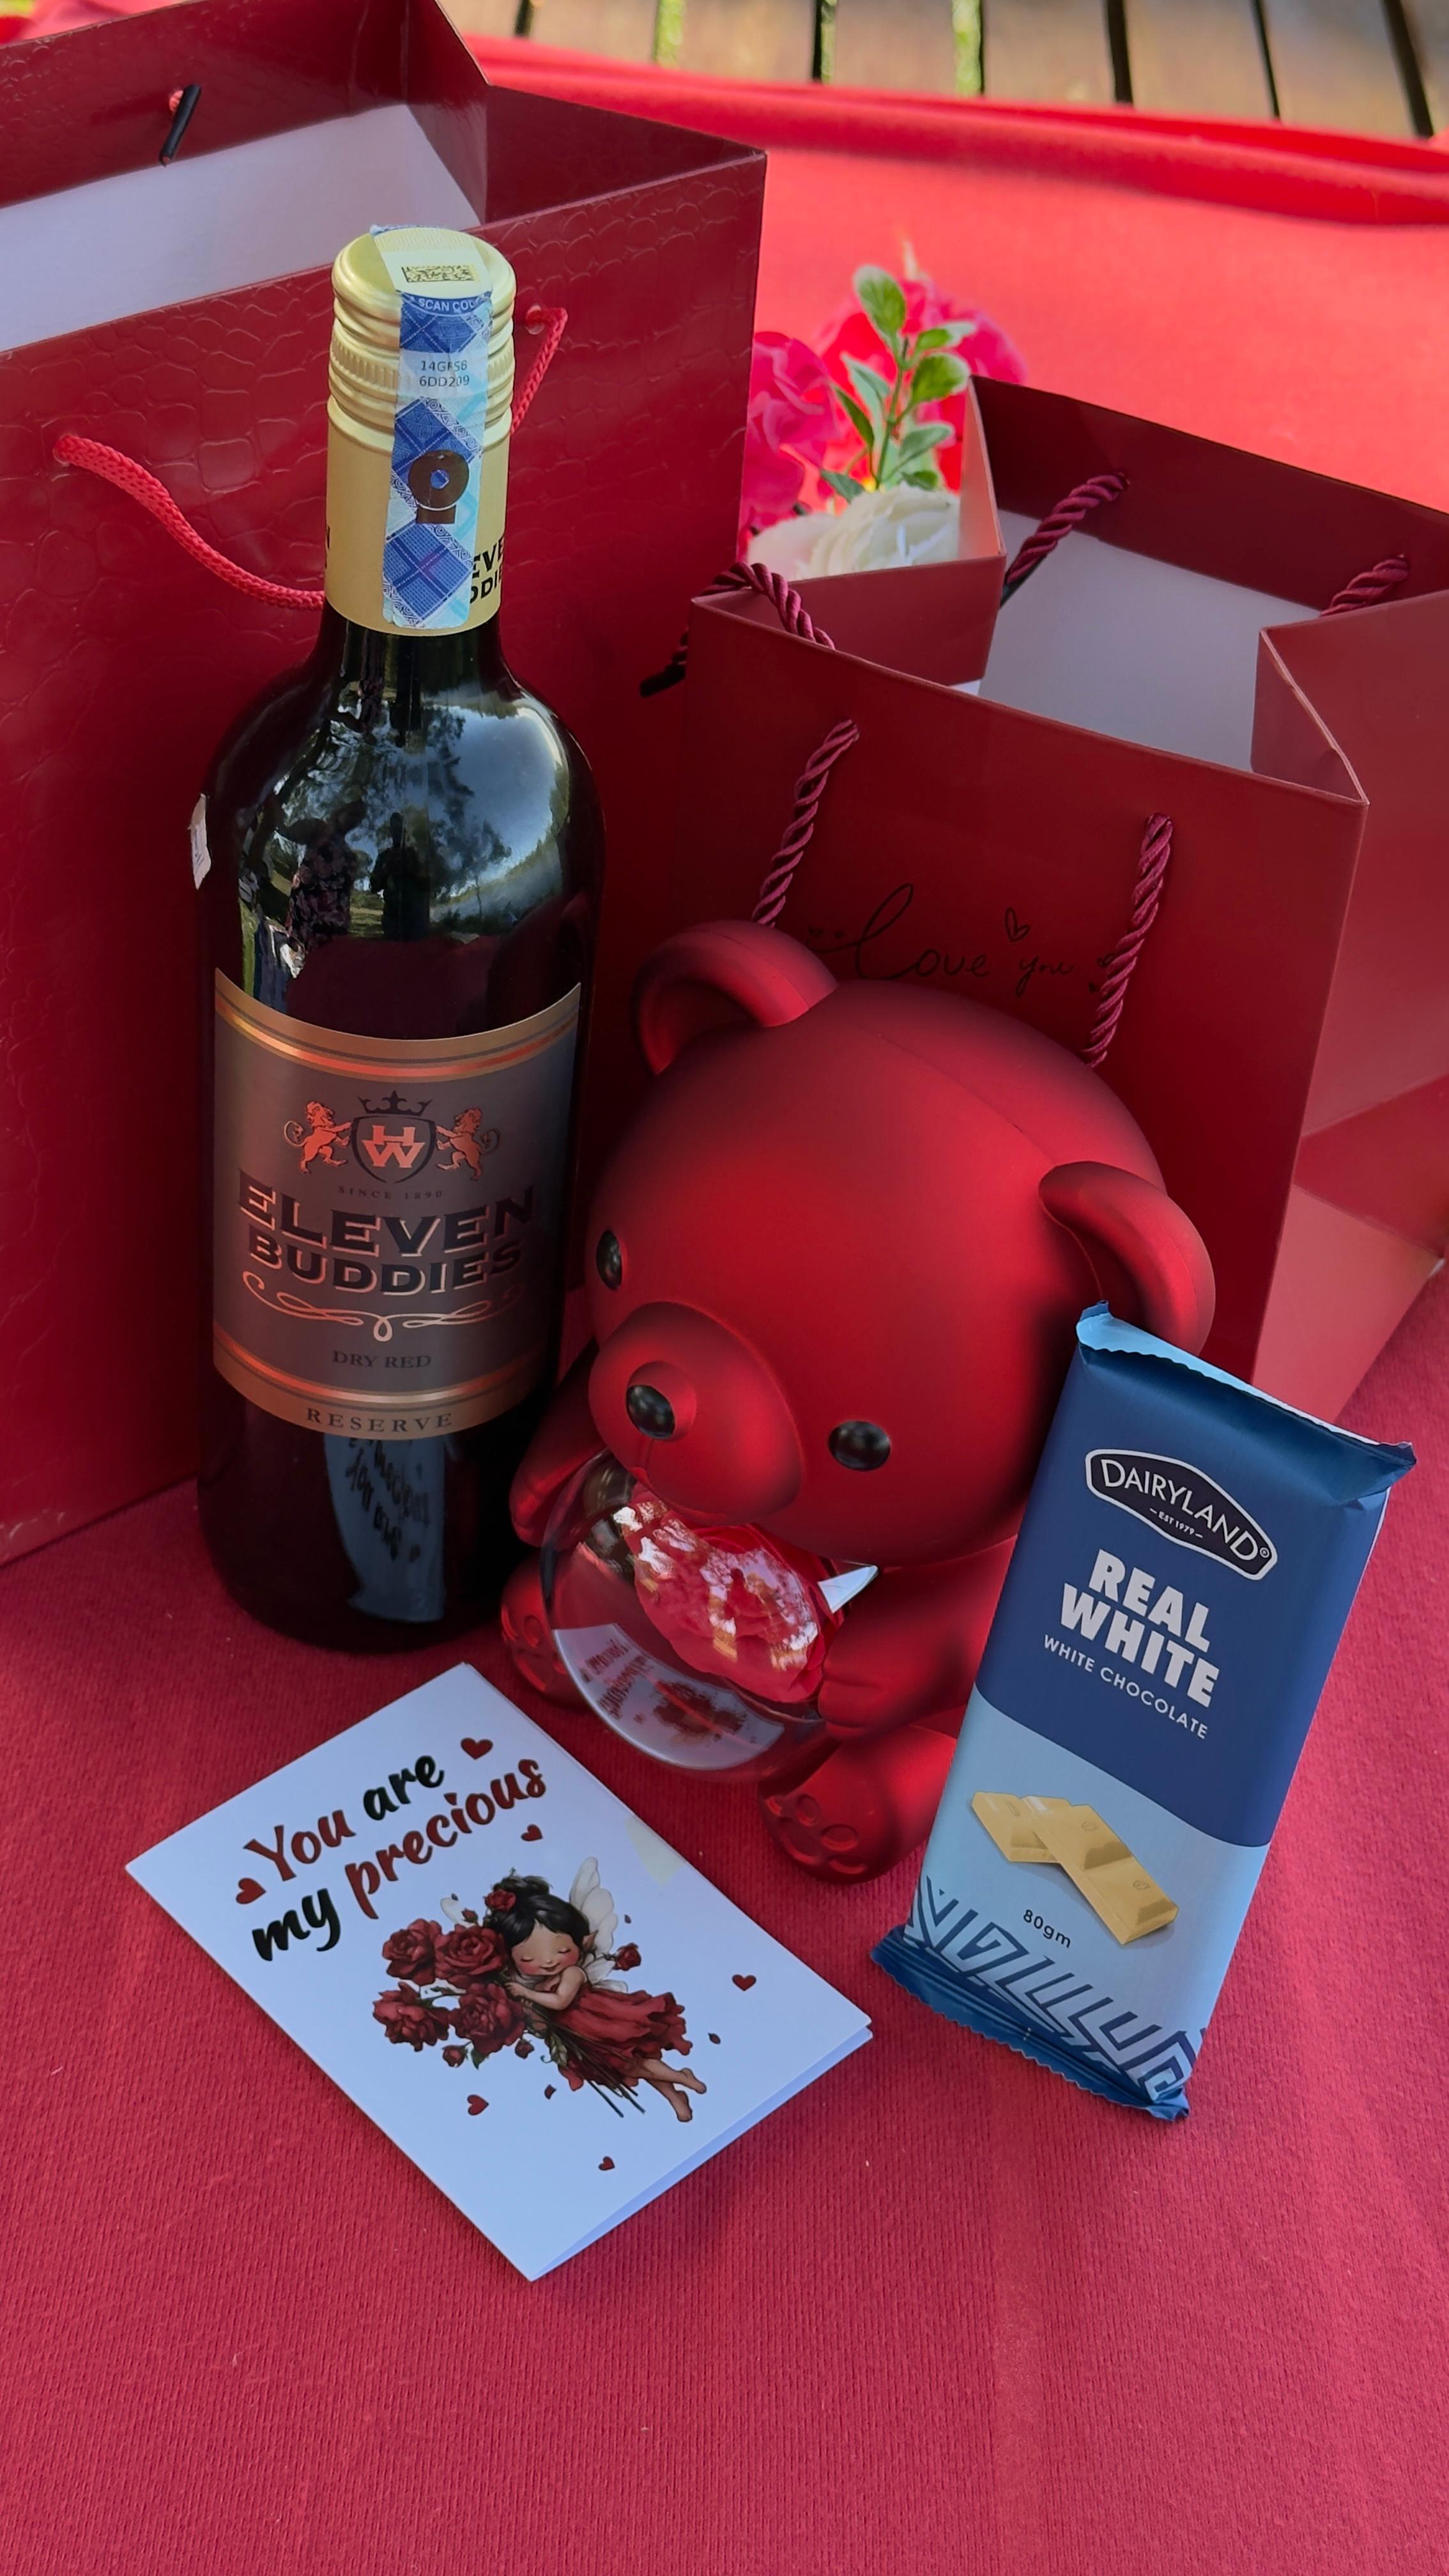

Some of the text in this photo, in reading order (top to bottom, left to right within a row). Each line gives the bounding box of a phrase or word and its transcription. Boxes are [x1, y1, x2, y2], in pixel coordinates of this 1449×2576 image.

[418, 298, 449, 312] SCAN
[238, 1172, 537, 1258] ELEVEN
[337, 1185, 443, 1200] SINCE 1890
[248, 1225, 521, 1296] BUDDIES
[332, 1349, 432, 1368] DRY RED
[306, 1407, 452, 1433] RESERVE
[1100, 1459, 1259, 1561] DAIRYLAND
[1158, 1510, 1195, 1535] EST 1979
[1089, 1548, 1210, 1653] REAL
[1061, 1583, 1220, 1708] WHITE
[1043, 1634, 1208, 1740] WHITE CHOCOLATE
[243, 1754, 445, 1882] You are
[251, 1758, 547, 1962] my precious
[1022, 1908, 1072, 1949] 80gm
